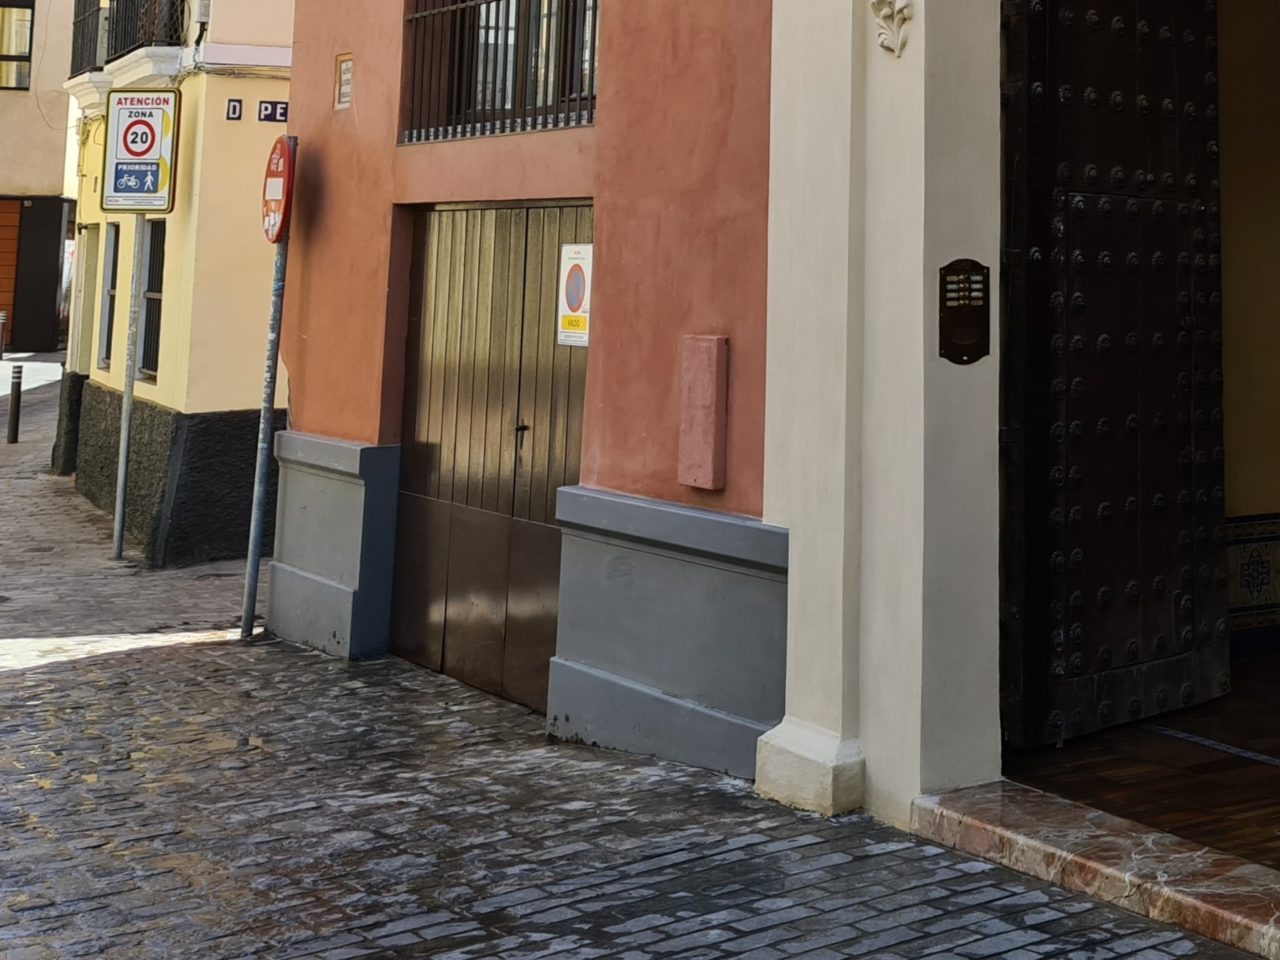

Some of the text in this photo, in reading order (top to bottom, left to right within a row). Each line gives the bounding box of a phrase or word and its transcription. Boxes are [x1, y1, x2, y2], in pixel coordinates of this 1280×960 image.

[116, 96, 170, 106] ATENCIÓN
[127, 111, 154, 119] ZONA
[130, 131, 149, 144] 20
